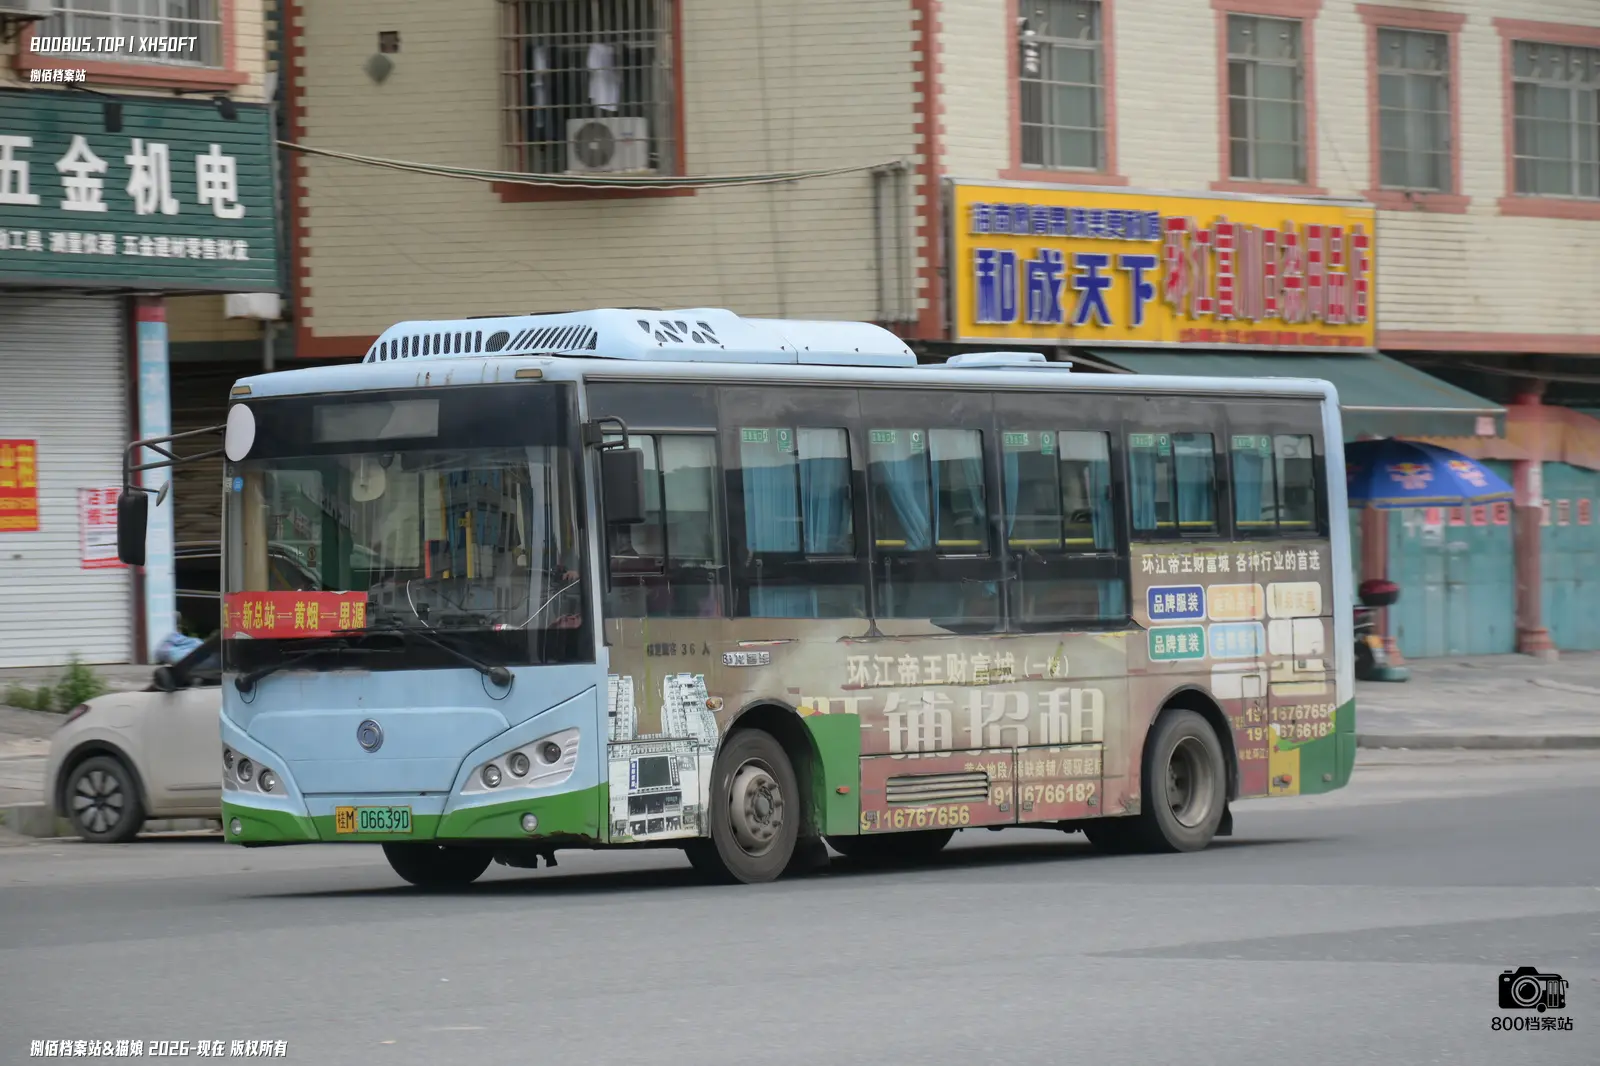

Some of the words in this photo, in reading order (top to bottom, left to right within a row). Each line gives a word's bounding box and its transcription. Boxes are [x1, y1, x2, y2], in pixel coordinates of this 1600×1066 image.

[0, 134, 246, 220] 五金机电
[973, 247, 1159, 327] 和成天下
[242, 601, 275, 630] 新总站
[1154, 592, 1199, 613] 品牌服装
[1154, 633, 1200, 654] 品牌童装
